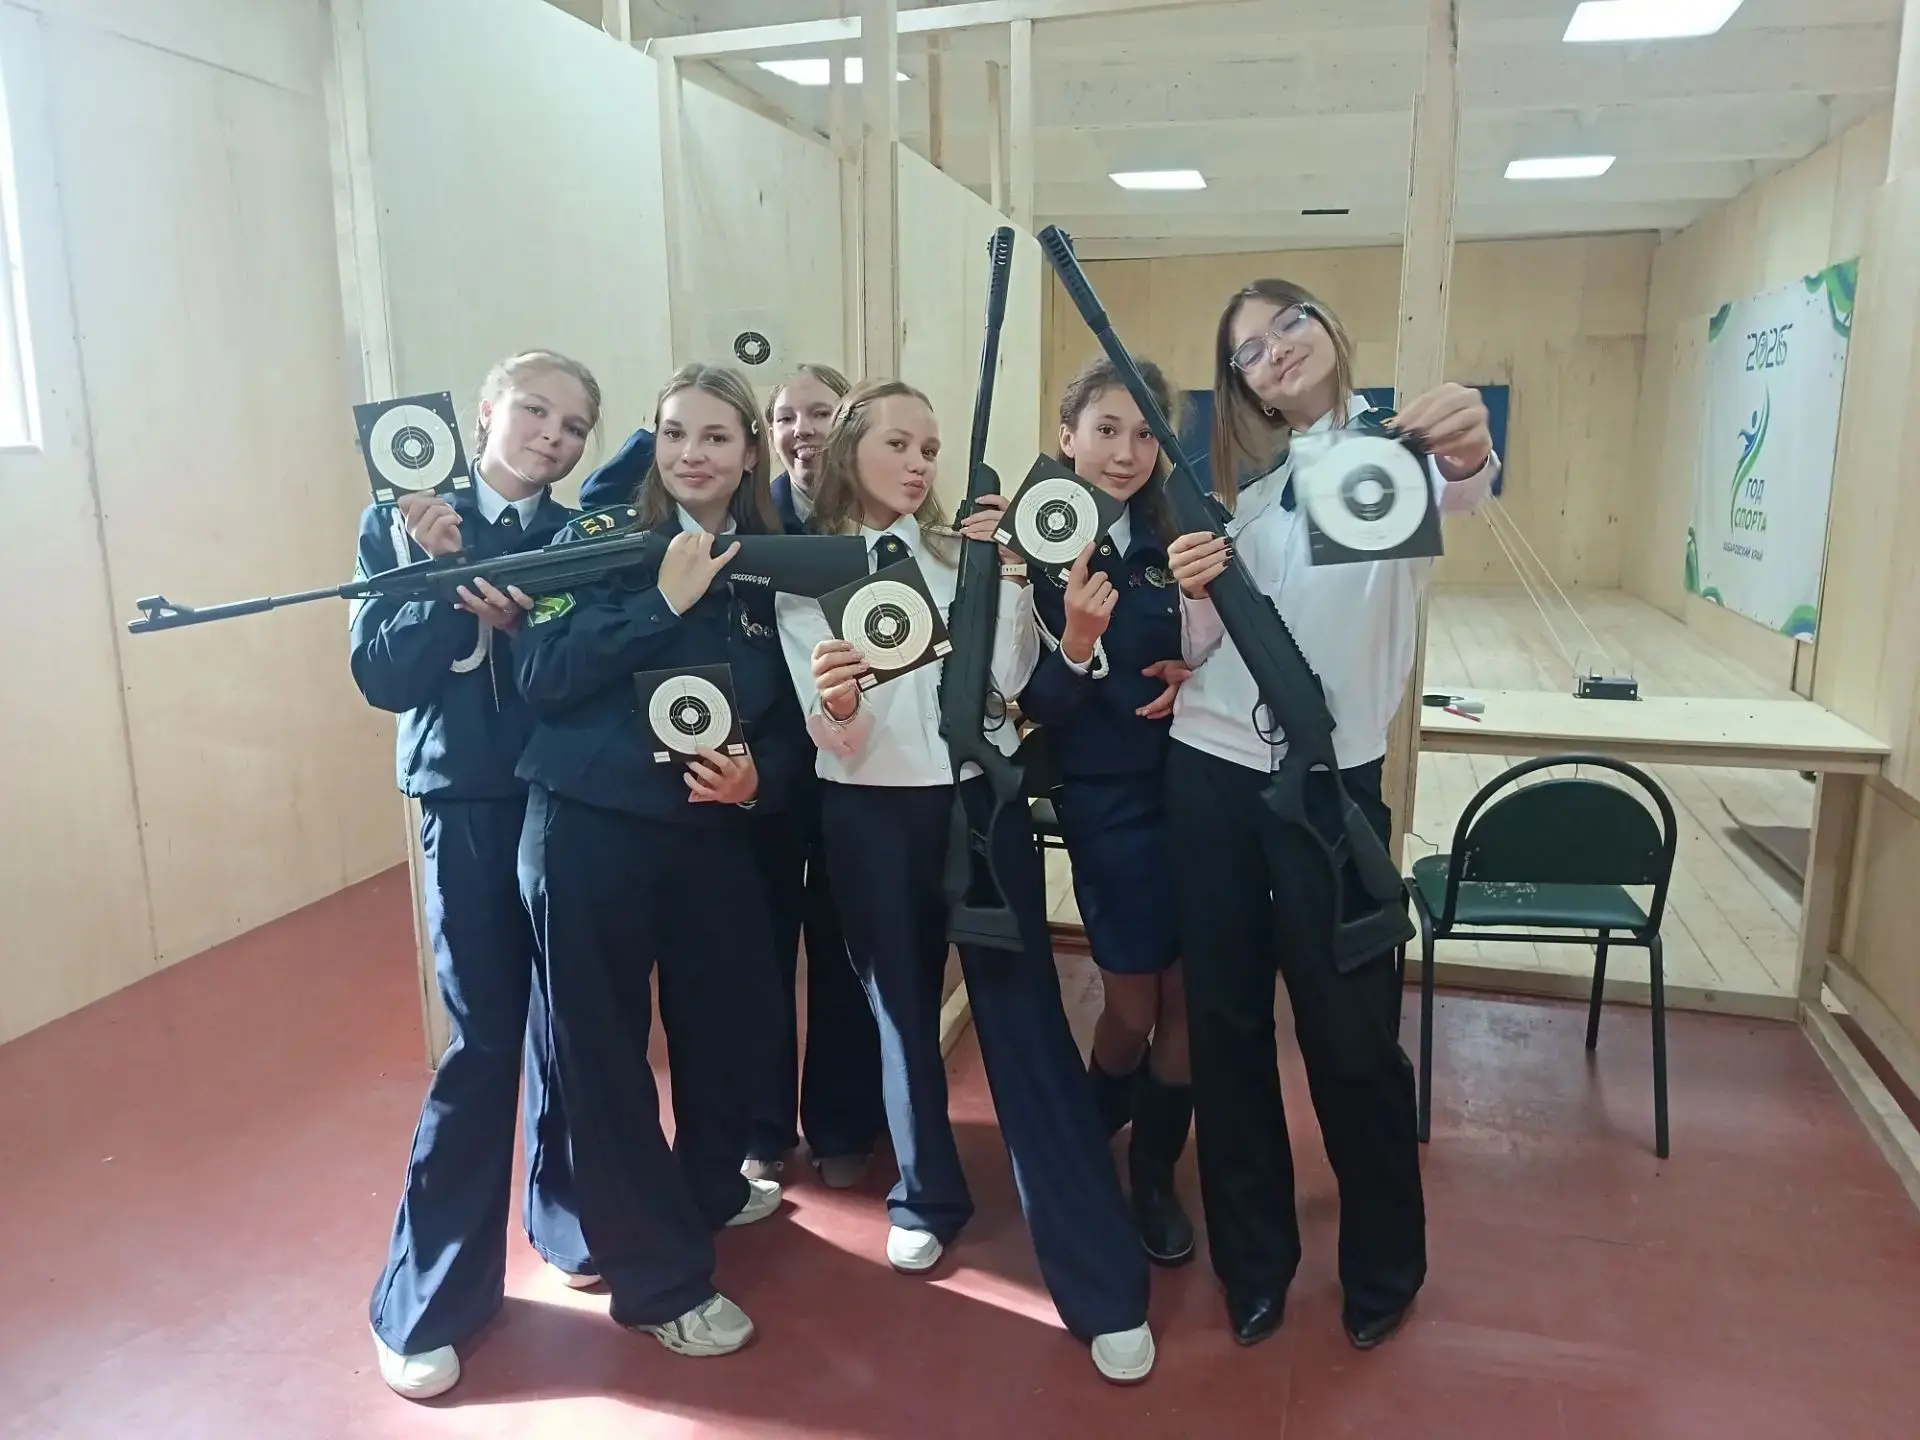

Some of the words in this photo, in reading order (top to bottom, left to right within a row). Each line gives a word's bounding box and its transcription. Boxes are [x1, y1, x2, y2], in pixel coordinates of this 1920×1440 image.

[1746, 323, 1793, 371] 2026
[1745, 478, 1765, 505] ГОД
[1734, 507, 1767, 533] СПОРТА
